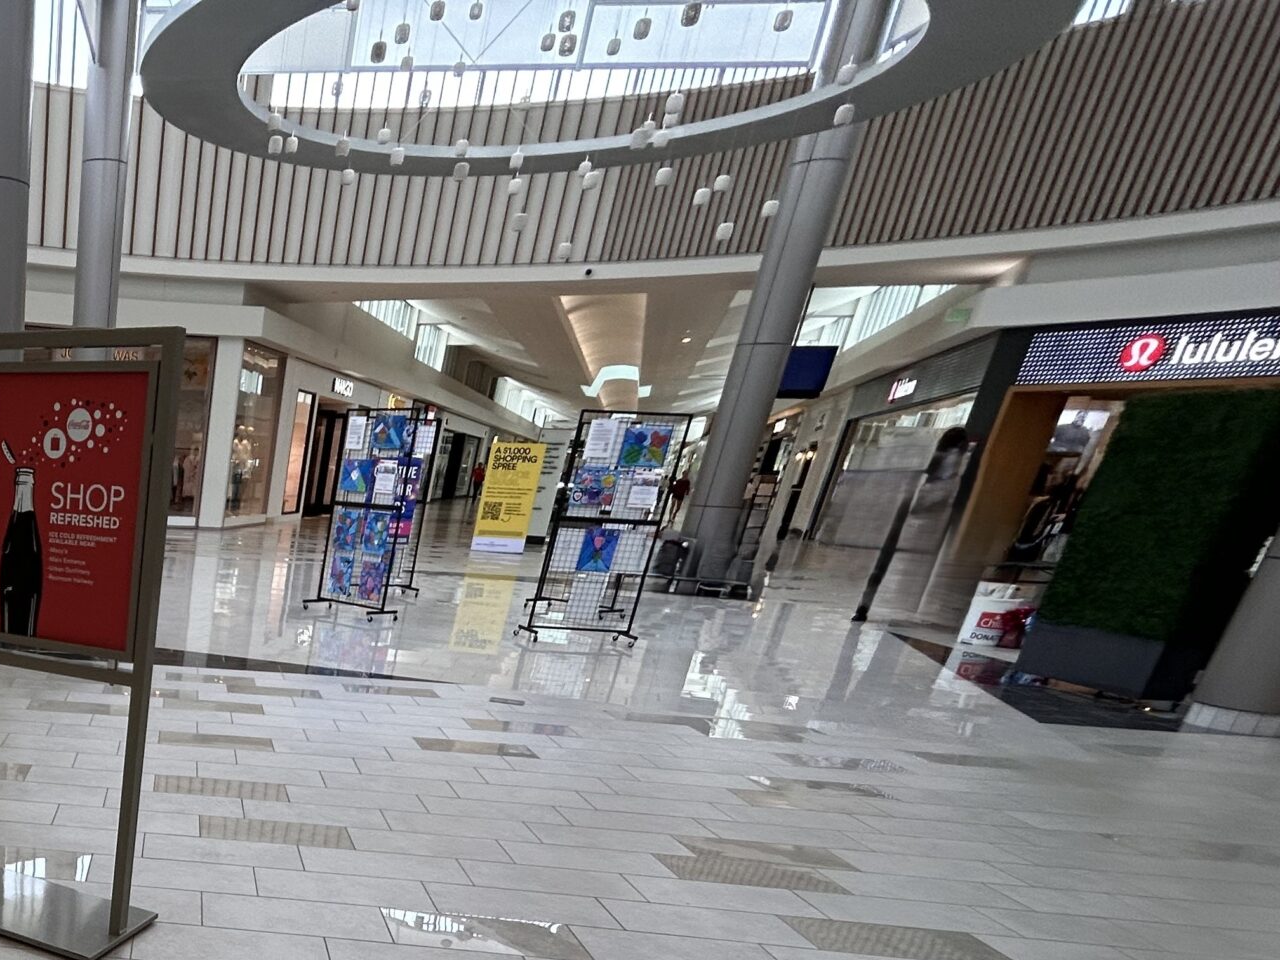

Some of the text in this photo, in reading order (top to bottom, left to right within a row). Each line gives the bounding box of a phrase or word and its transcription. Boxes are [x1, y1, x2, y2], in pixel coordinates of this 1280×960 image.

[113, 349, 139, 361] WAS
[493, 454, 538, 464] SHOPPING
[492, 462, 517, 471] SPREE
[50, 481, 125, 513] SHOP
[49, 512, 120, 529] REFRESHED
